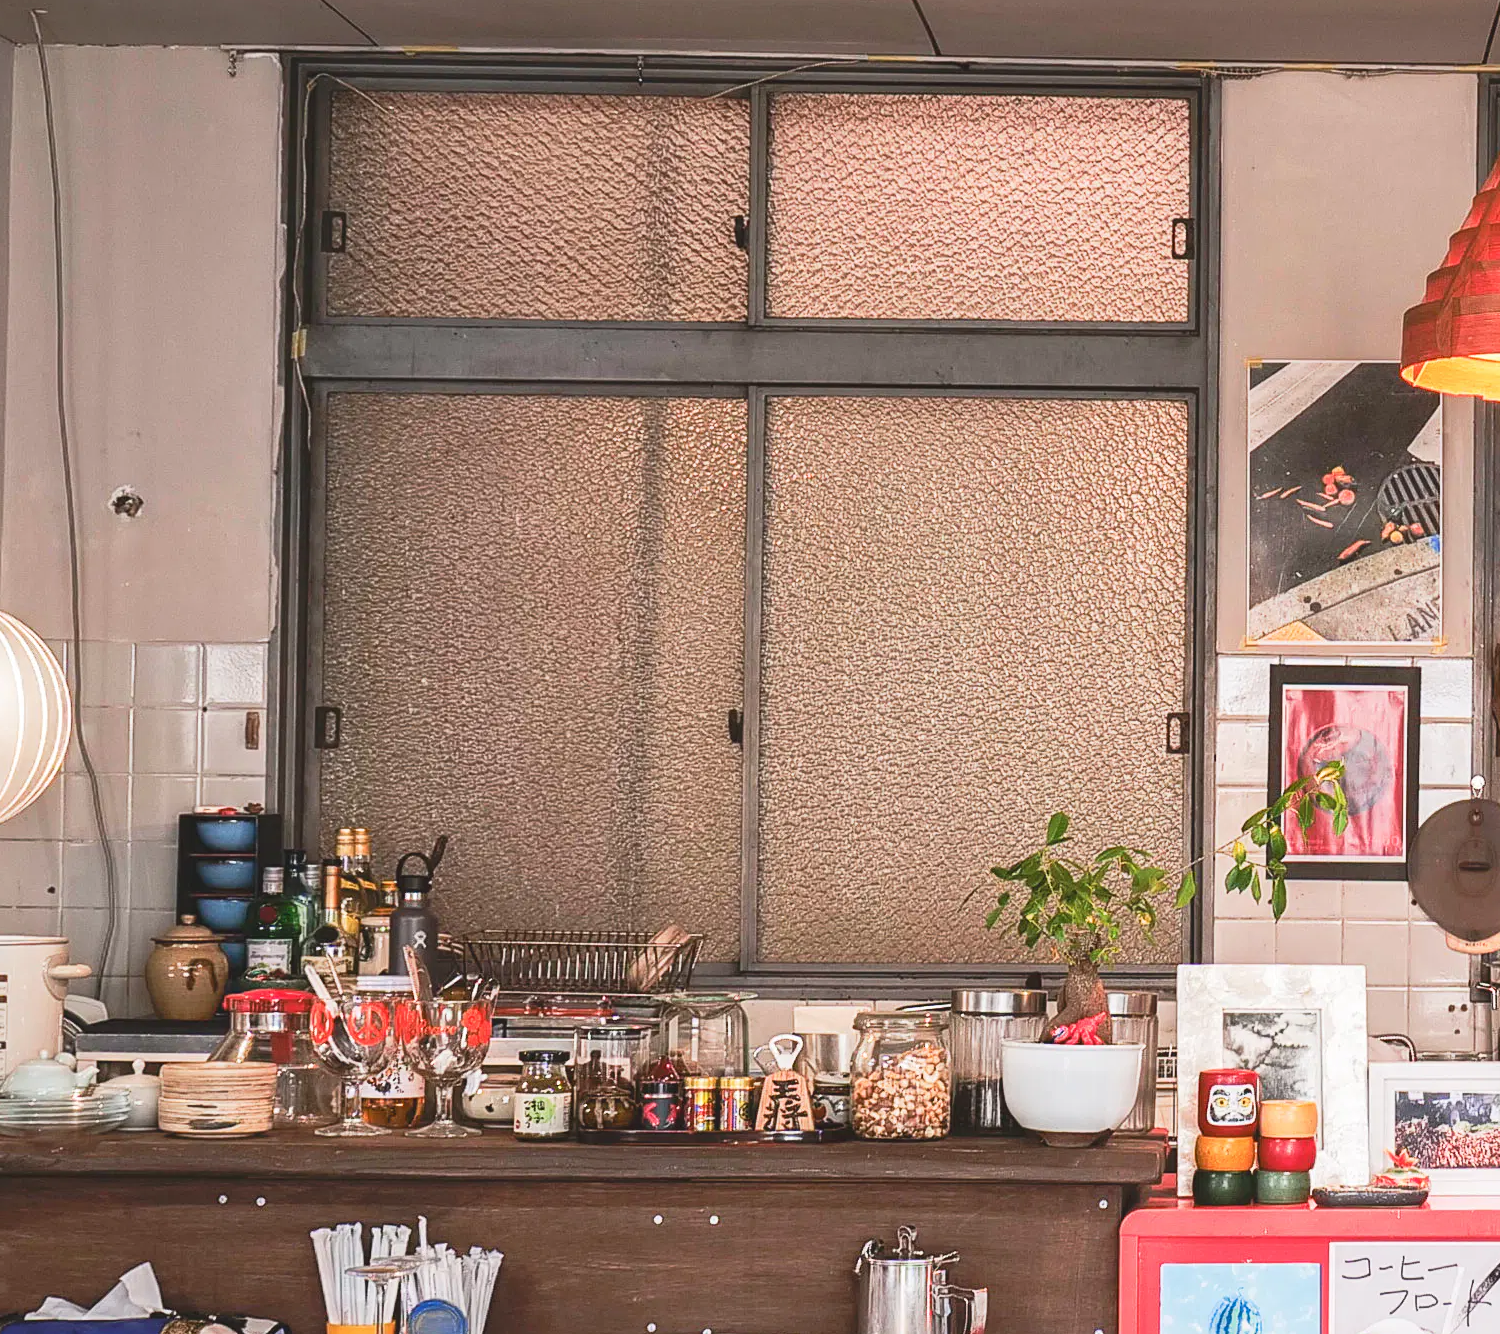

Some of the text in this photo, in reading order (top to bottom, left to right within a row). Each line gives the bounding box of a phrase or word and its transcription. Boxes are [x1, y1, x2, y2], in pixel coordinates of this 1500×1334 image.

[1388, 596, 1440, 641] LAN
[763, 1079, 808, 1131] 王将
[1342, 1255, 1458, 1281] コーヒー
[1380, 1279, 1492, 1327] フロート
